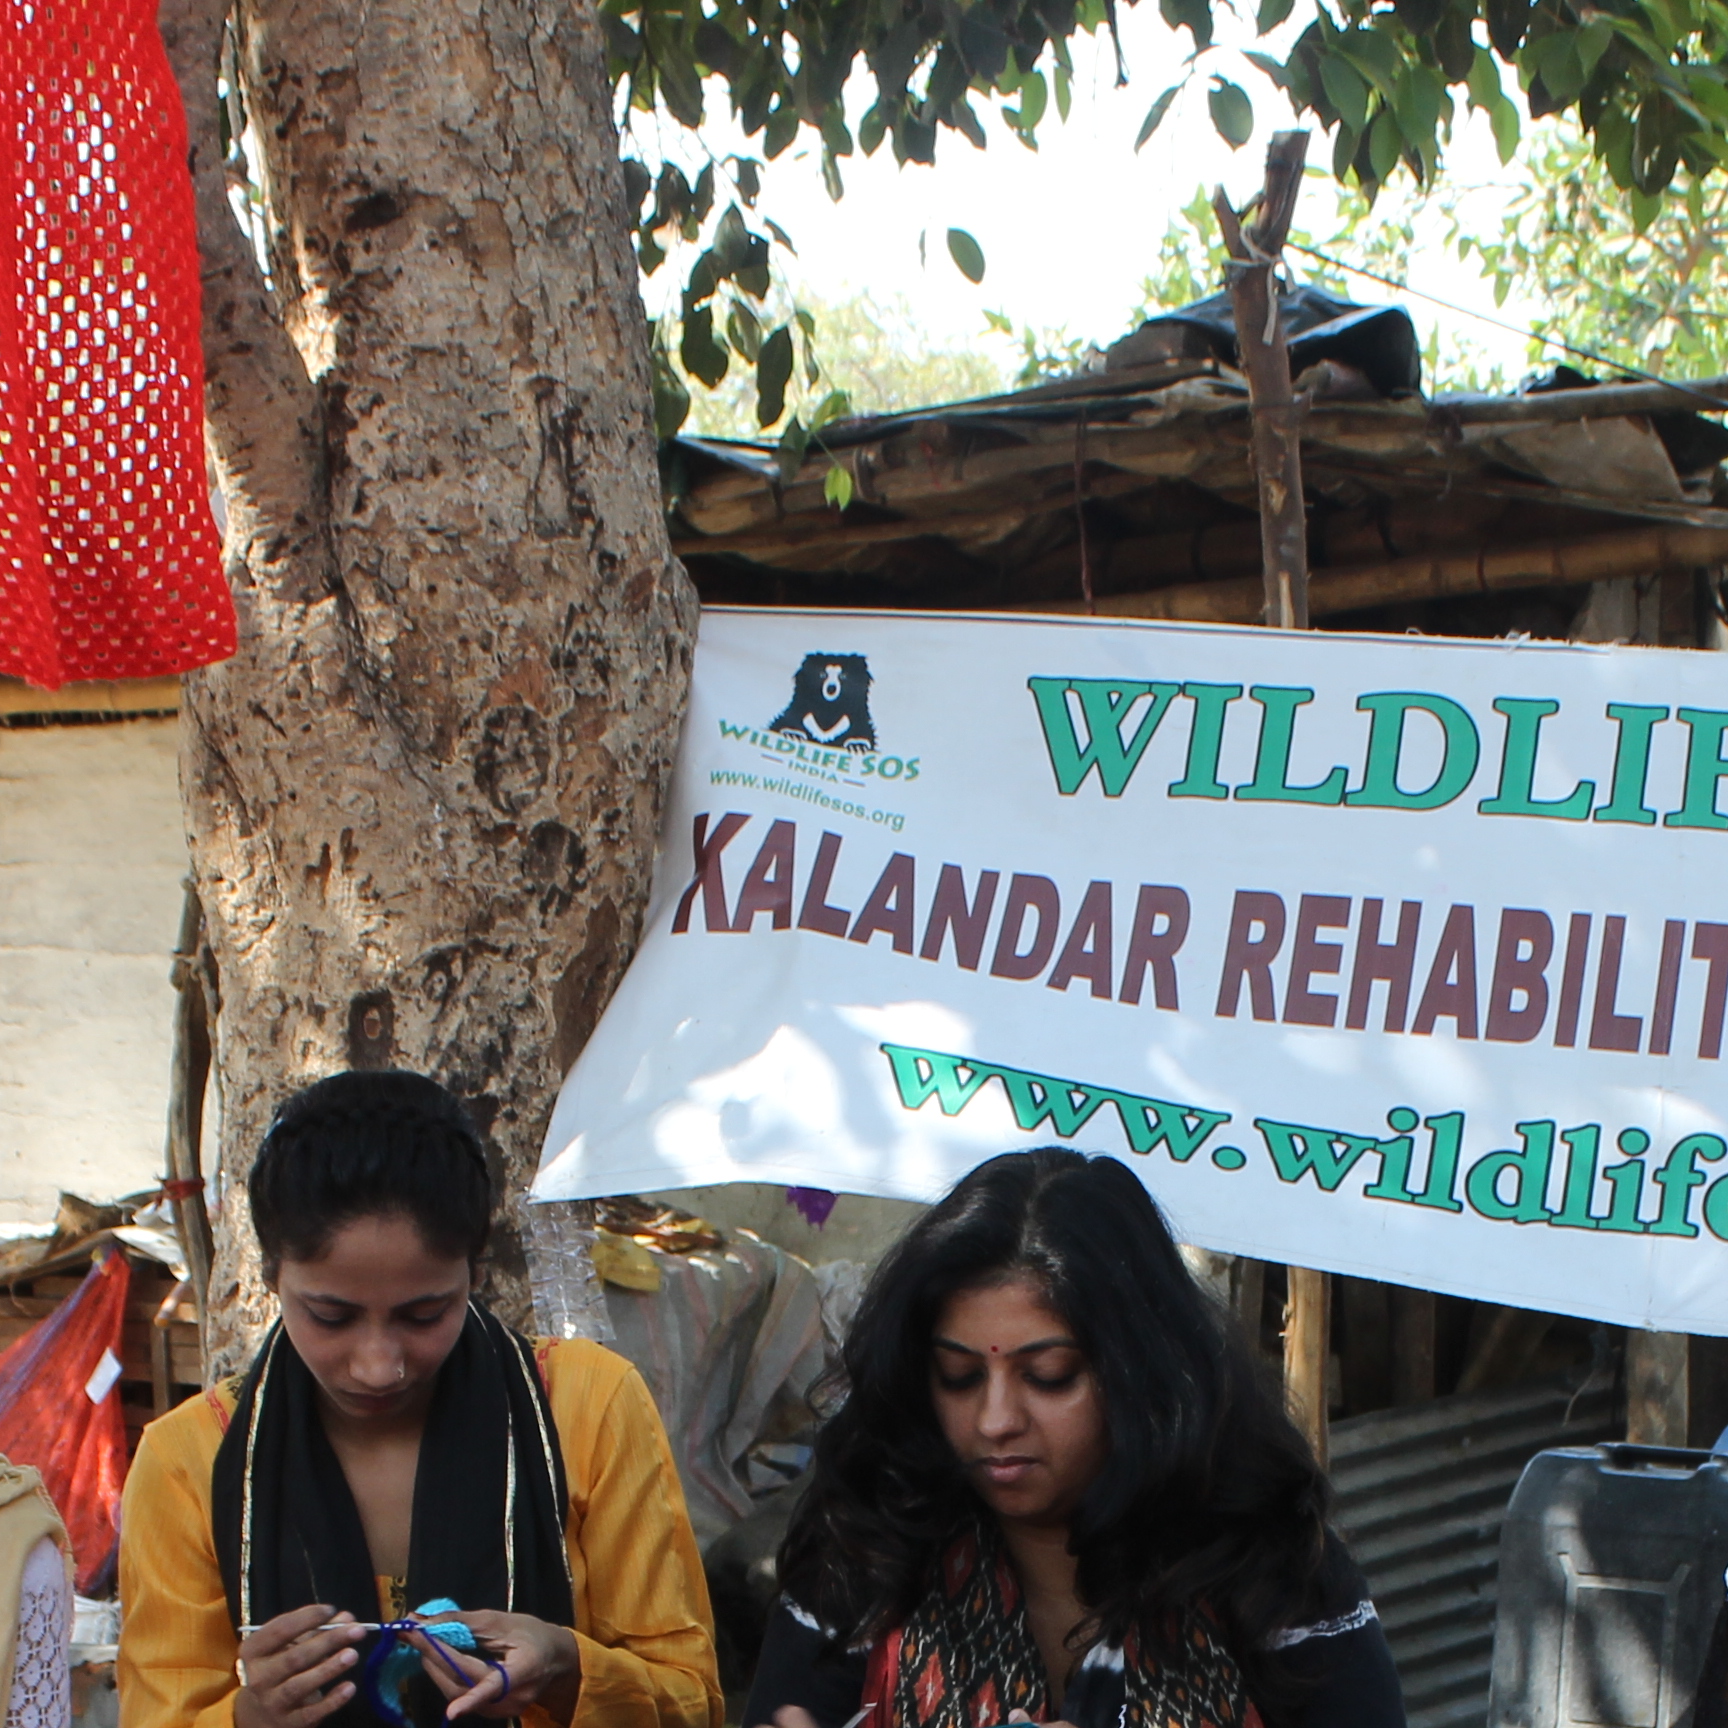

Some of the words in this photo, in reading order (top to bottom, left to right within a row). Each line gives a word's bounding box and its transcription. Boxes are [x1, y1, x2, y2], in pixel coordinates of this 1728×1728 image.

[719, 719, 852, 773] WILDLIFE
[861, 753, 921, 782] SOS
[787, 759, 839, 784] INDIA
[709, 769, 906, 831] www.wildlifesos.org
[670, 812, 1188, 1011] KALANDAR
